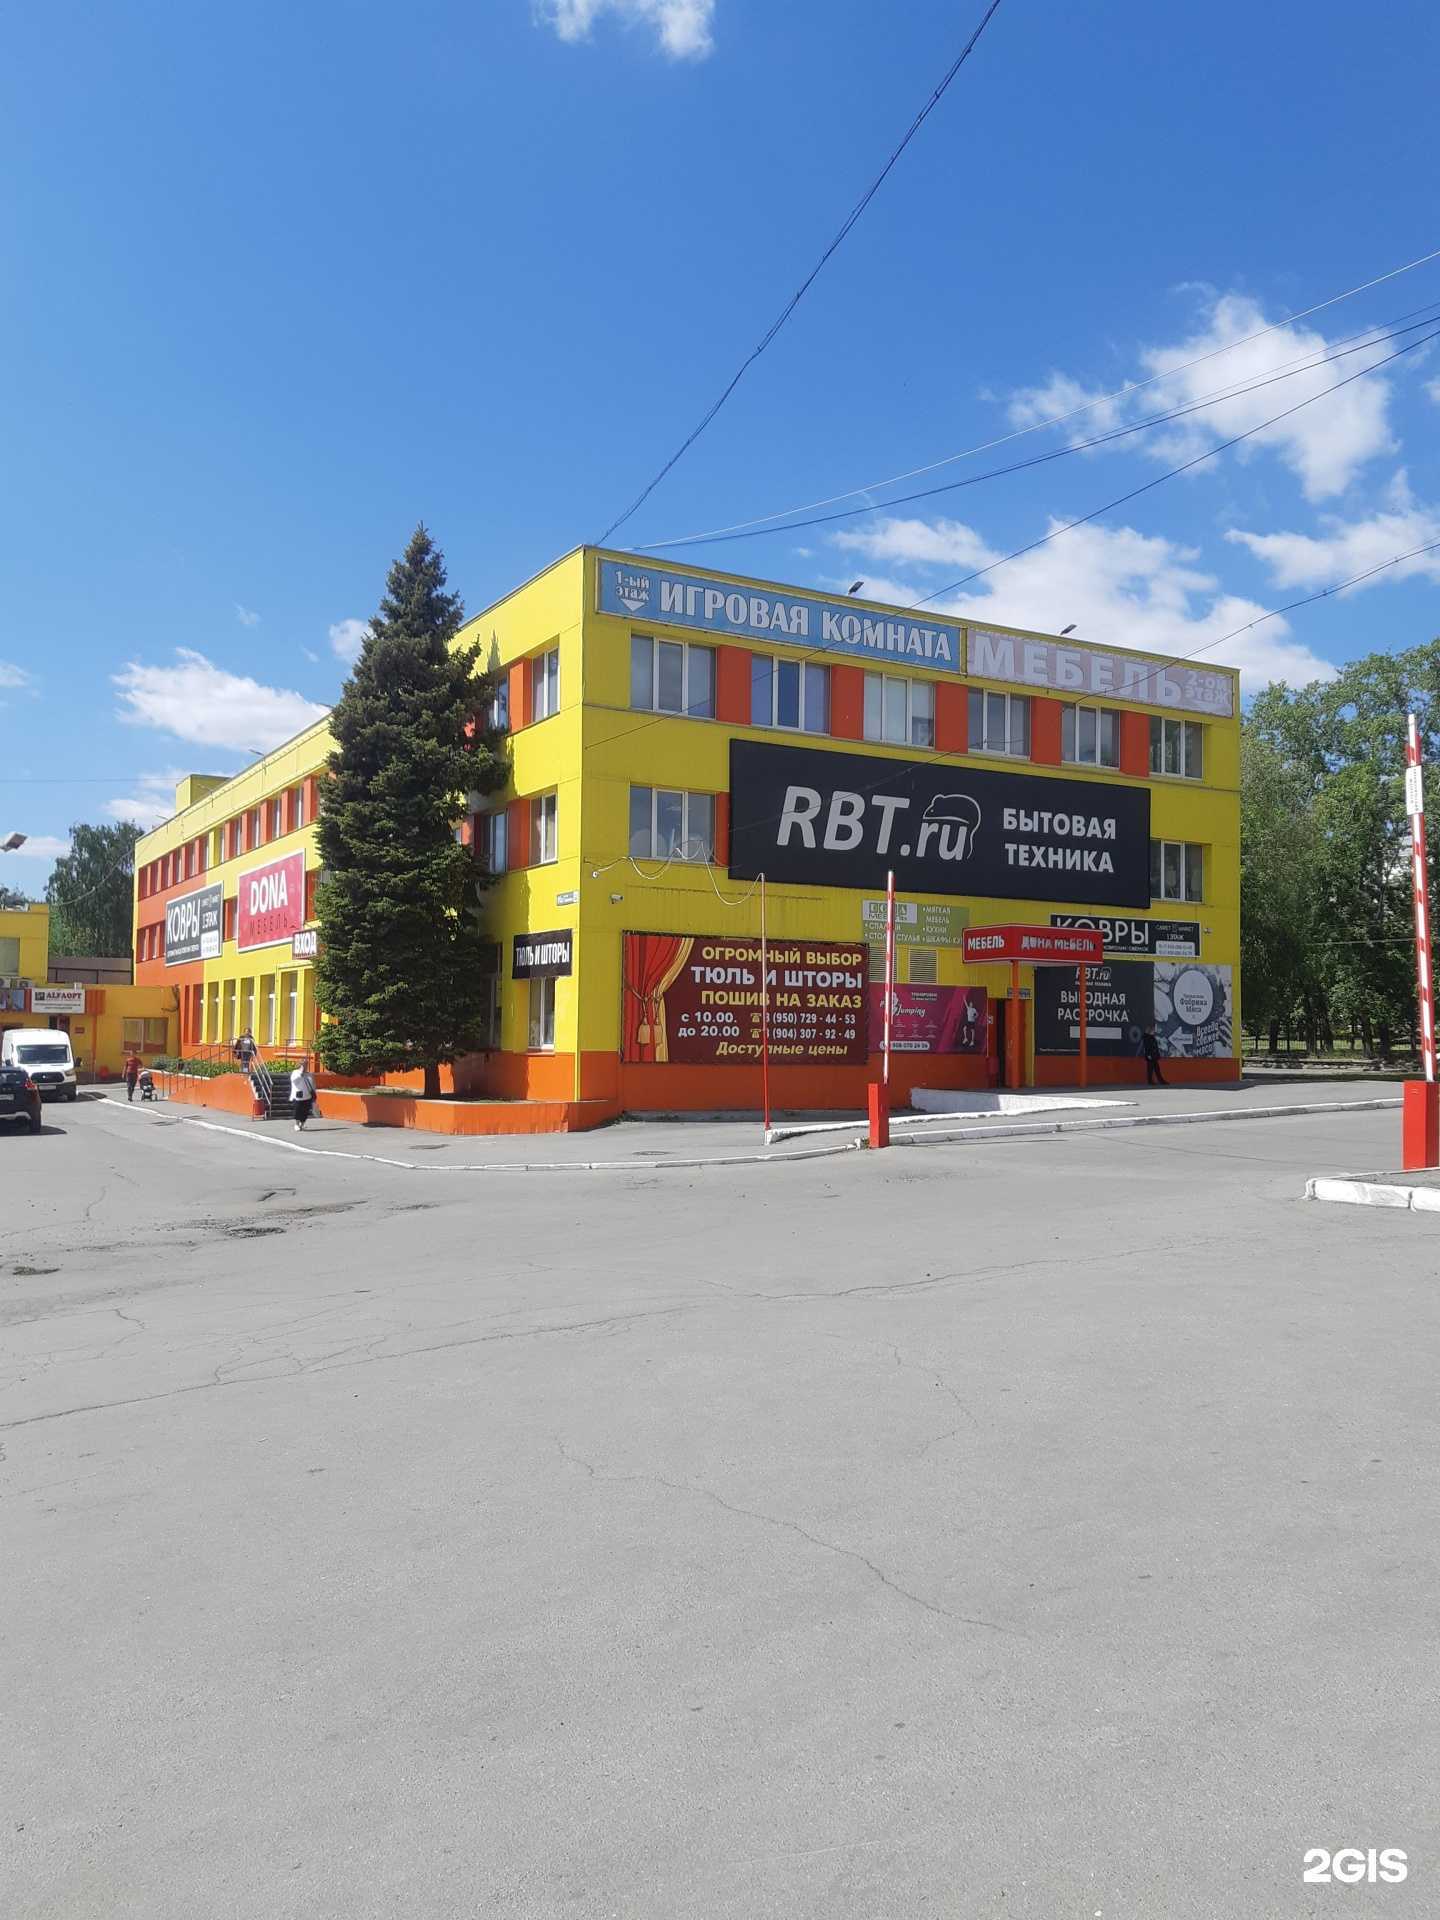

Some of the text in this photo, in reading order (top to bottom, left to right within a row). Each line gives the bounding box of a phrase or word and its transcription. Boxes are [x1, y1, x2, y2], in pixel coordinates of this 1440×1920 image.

[615, 570, 649, 589] 1-ый
[615, 586, 649, 601] этаж
[660, 580, 952, 661] ИГРОВАЯ КОМНАТА
[974, 633, 1182, 704] МЕБЕЛЬ
[776, 785, 967, 861] RBT.ru
[1003, 807, 1116, 840] БЫТОВАЯ
[1005, 843, 1114, 873] ТЕХНИКА
[250, 869, 288, 916] DONA
[166, 899, 200, 945] КОВРЫ
[294, 931, 317, 955] ВХОД
[968, 935, 1005, 951] МЕБЕЛЬ
[1054, 938, 1096, 952] МЕБЕЛЬ
[516, 941, 570, 966] ТЮЛЬ И ШТОРЫ
[702, 947, 862, 966] ОГРОМНЫЙ ВЫБОР
[691, 966, 755, 985] ТЮЛЬ
[784, 970, 863, 988] ШТОРЫ
[701, 990, 770, 1006] ПОШИВ
[776, 994, 801, 1008] НА
[807, 993, 862, 1009] ЗАКАЗ
[1061, 990, 1126, 1006] ВЫОДНАЯ
[697, 1011, 737, 1024] 10.00.
[772, 1012, 798, 1025] (950)
[800, 1013, 817, 1024] 729
[825, 1014, 837, 1025] 44
[844, 1014, 856, 1025] 53
[1058, 1007, 1129, 1023] РАСРОЧКА
[678, 1025, 739, 1037] до 20.00
[772, 1027, 798, 1040] (904)
[800, 1028, 817, 1039] 307
[825, 1029, 837, 1039] 92
[844, 1029, 856, 1040] 49
[716, 1041, 848, 1057] Доступные цены
